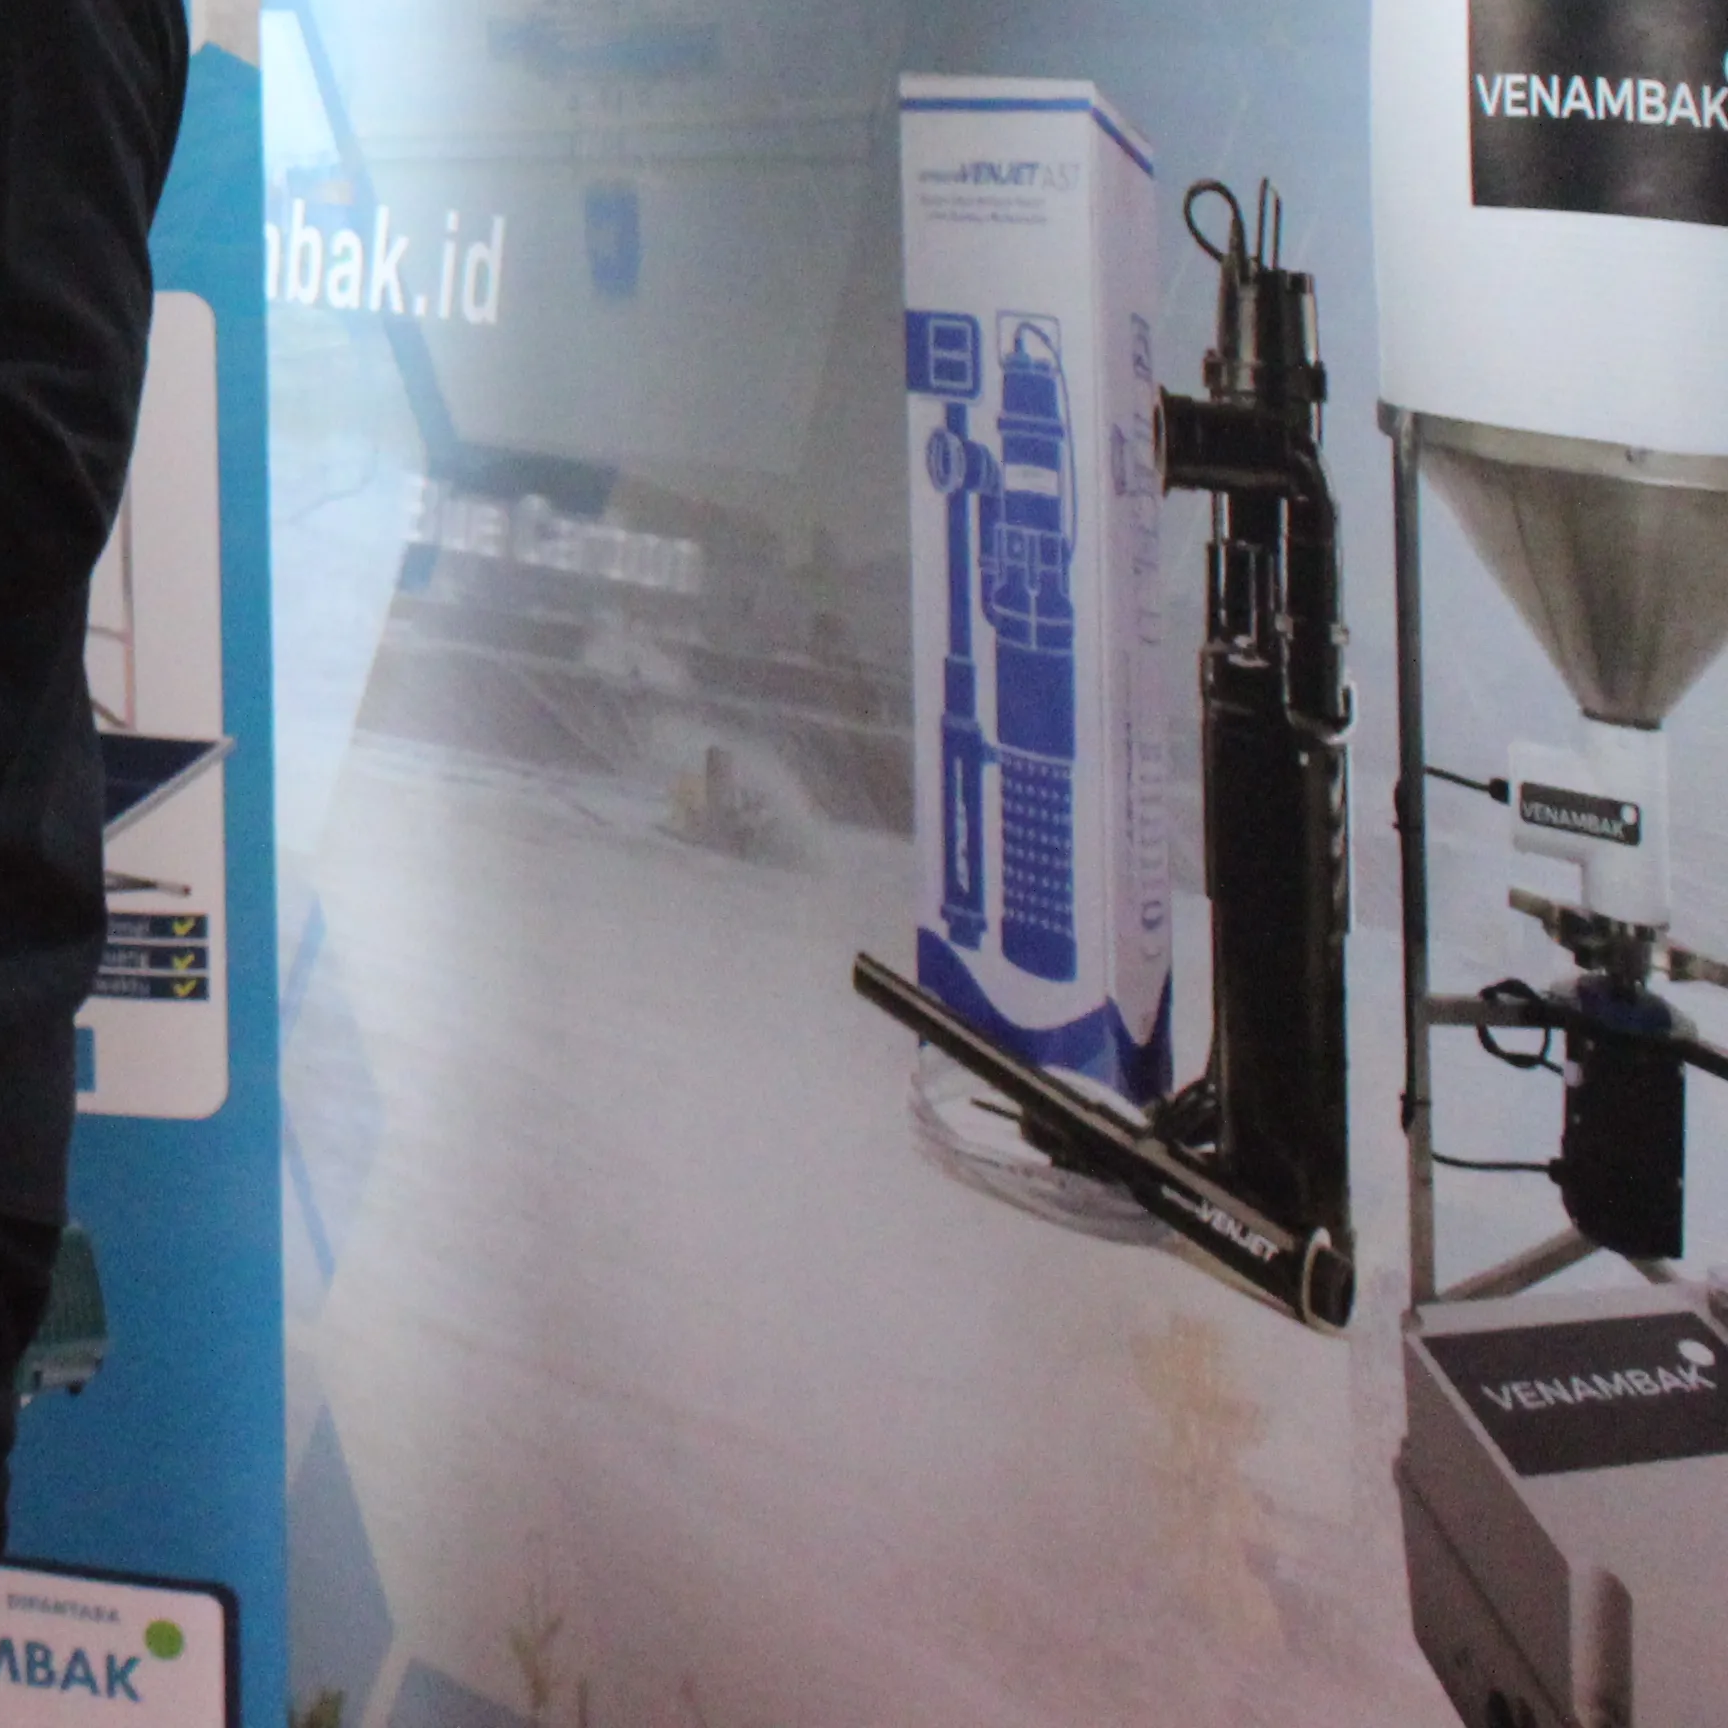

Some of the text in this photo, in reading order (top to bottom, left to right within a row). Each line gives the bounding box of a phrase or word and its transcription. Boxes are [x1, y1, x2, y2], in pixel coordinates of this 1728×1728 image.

[1475, 73, 1728, 132] VENAMBAK
[1522, 802, 1627, 839] VENAMBAK
[1481, 1363, 1717, 1412] VENAMBAK
